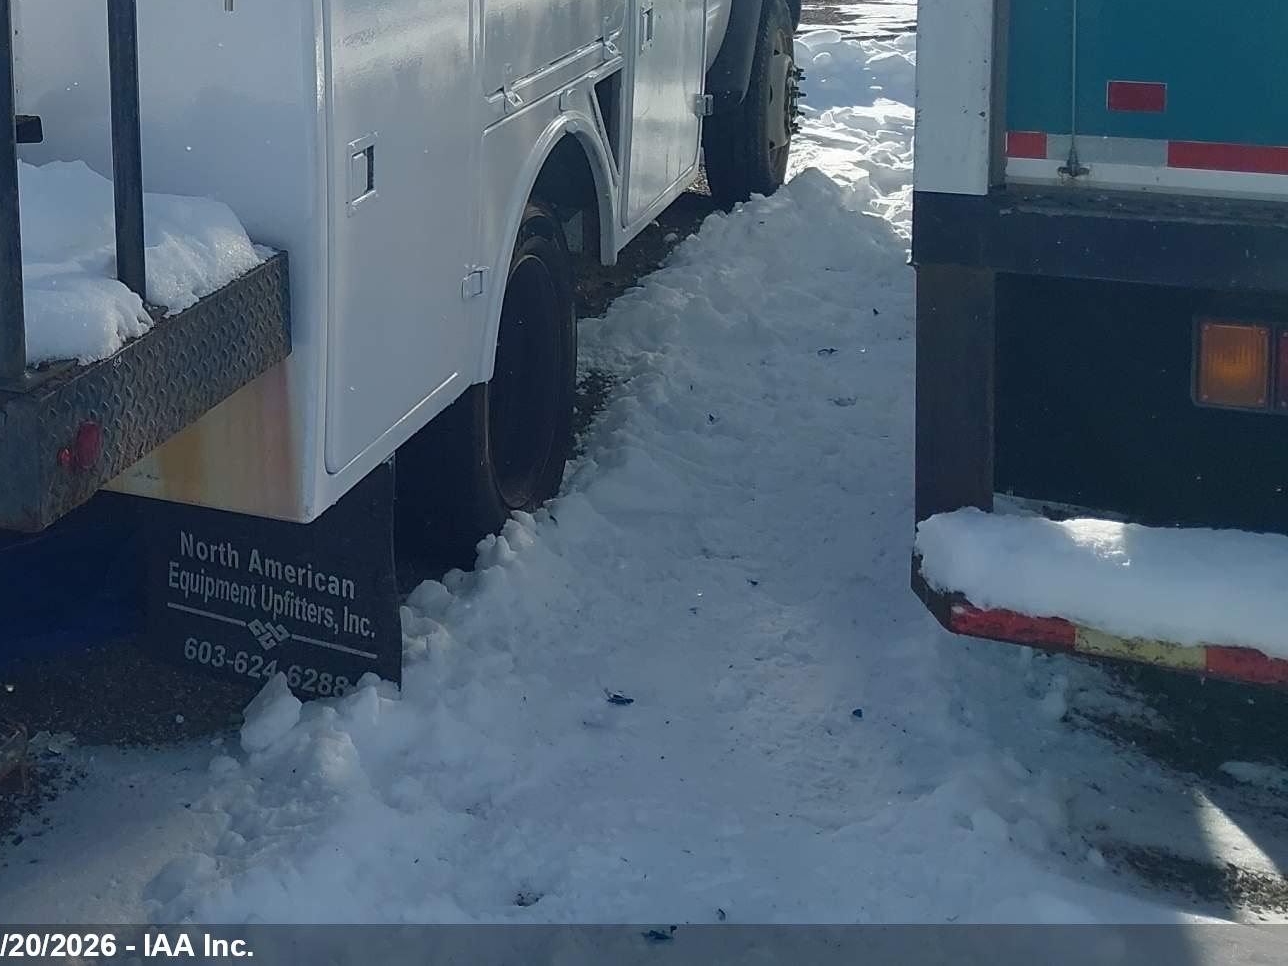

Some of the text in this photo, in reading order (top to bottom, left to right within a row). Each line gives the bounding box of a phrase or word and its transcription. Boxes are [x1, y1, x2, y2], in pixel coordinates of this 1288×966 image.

[168, 561, 377, 639] Equipment Upfitters, Inc.
[180, 530, 356, 600] North American
[184, 636, 350, 698] 603-6246288
